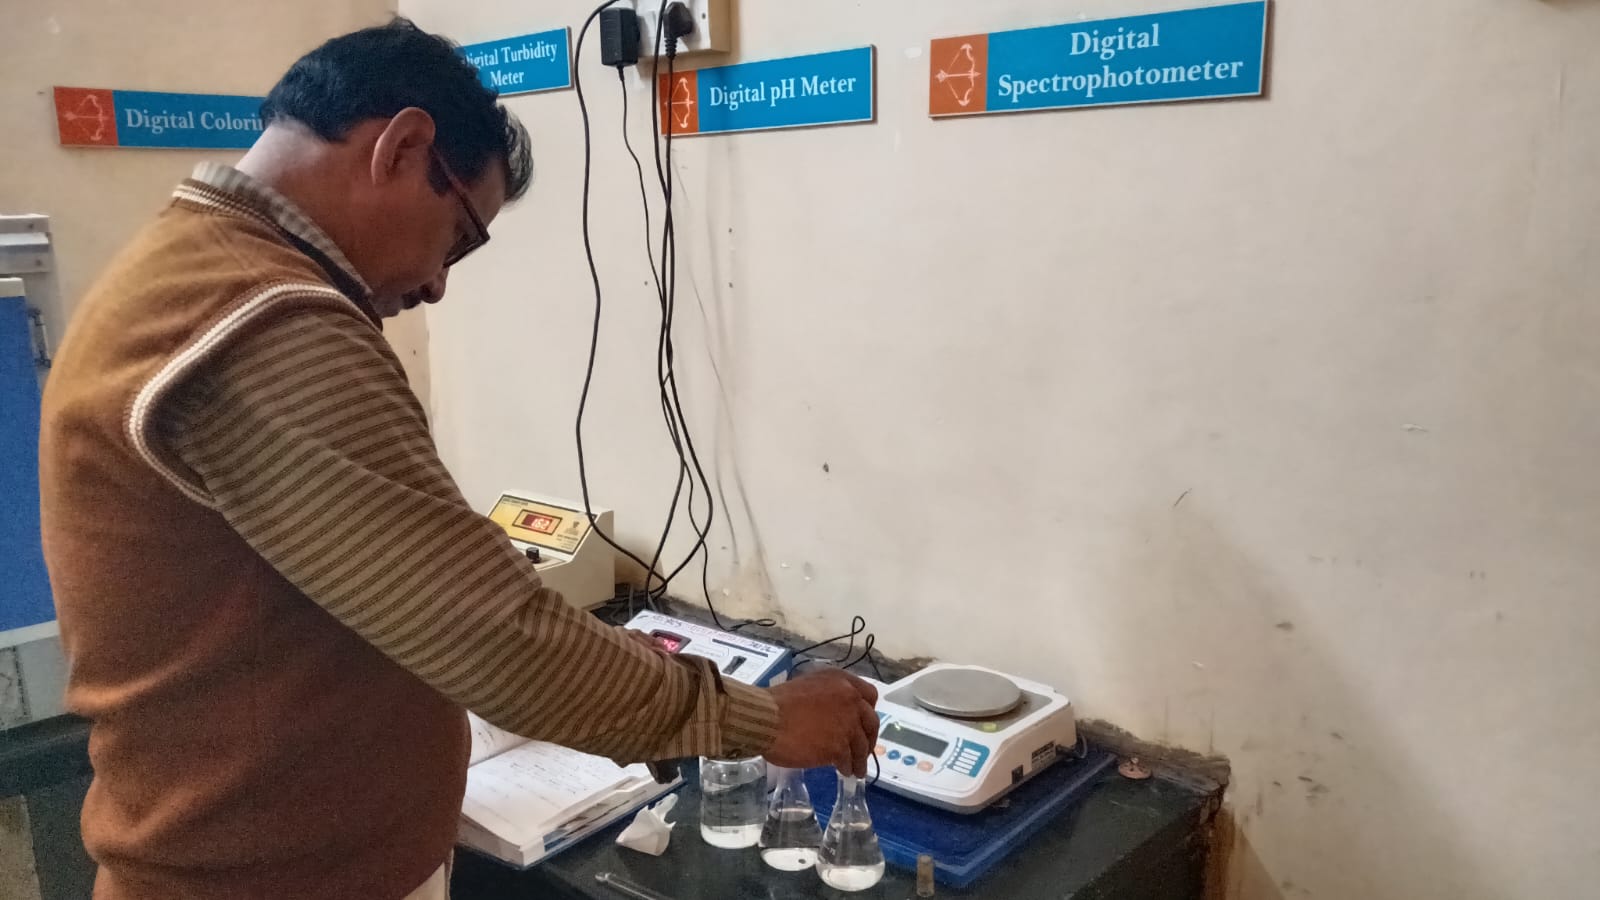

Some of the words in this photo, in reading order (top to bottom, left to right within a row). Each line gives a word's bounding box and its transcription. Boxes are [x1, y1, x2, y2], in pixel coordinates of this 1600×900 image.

[501, 41, 558, 62] Turbidity
[1069, 23, 1160, 60] Digital
[490, 70, 525, 88] Meter
[710, 82, 766, 111] Digital
[770, 78, 796, 107] pH
[801, 75, 857, 97] Meter
[998, 60, 1244, 103] Spectrophotometer
[124, 108, 195, 135] Digital
